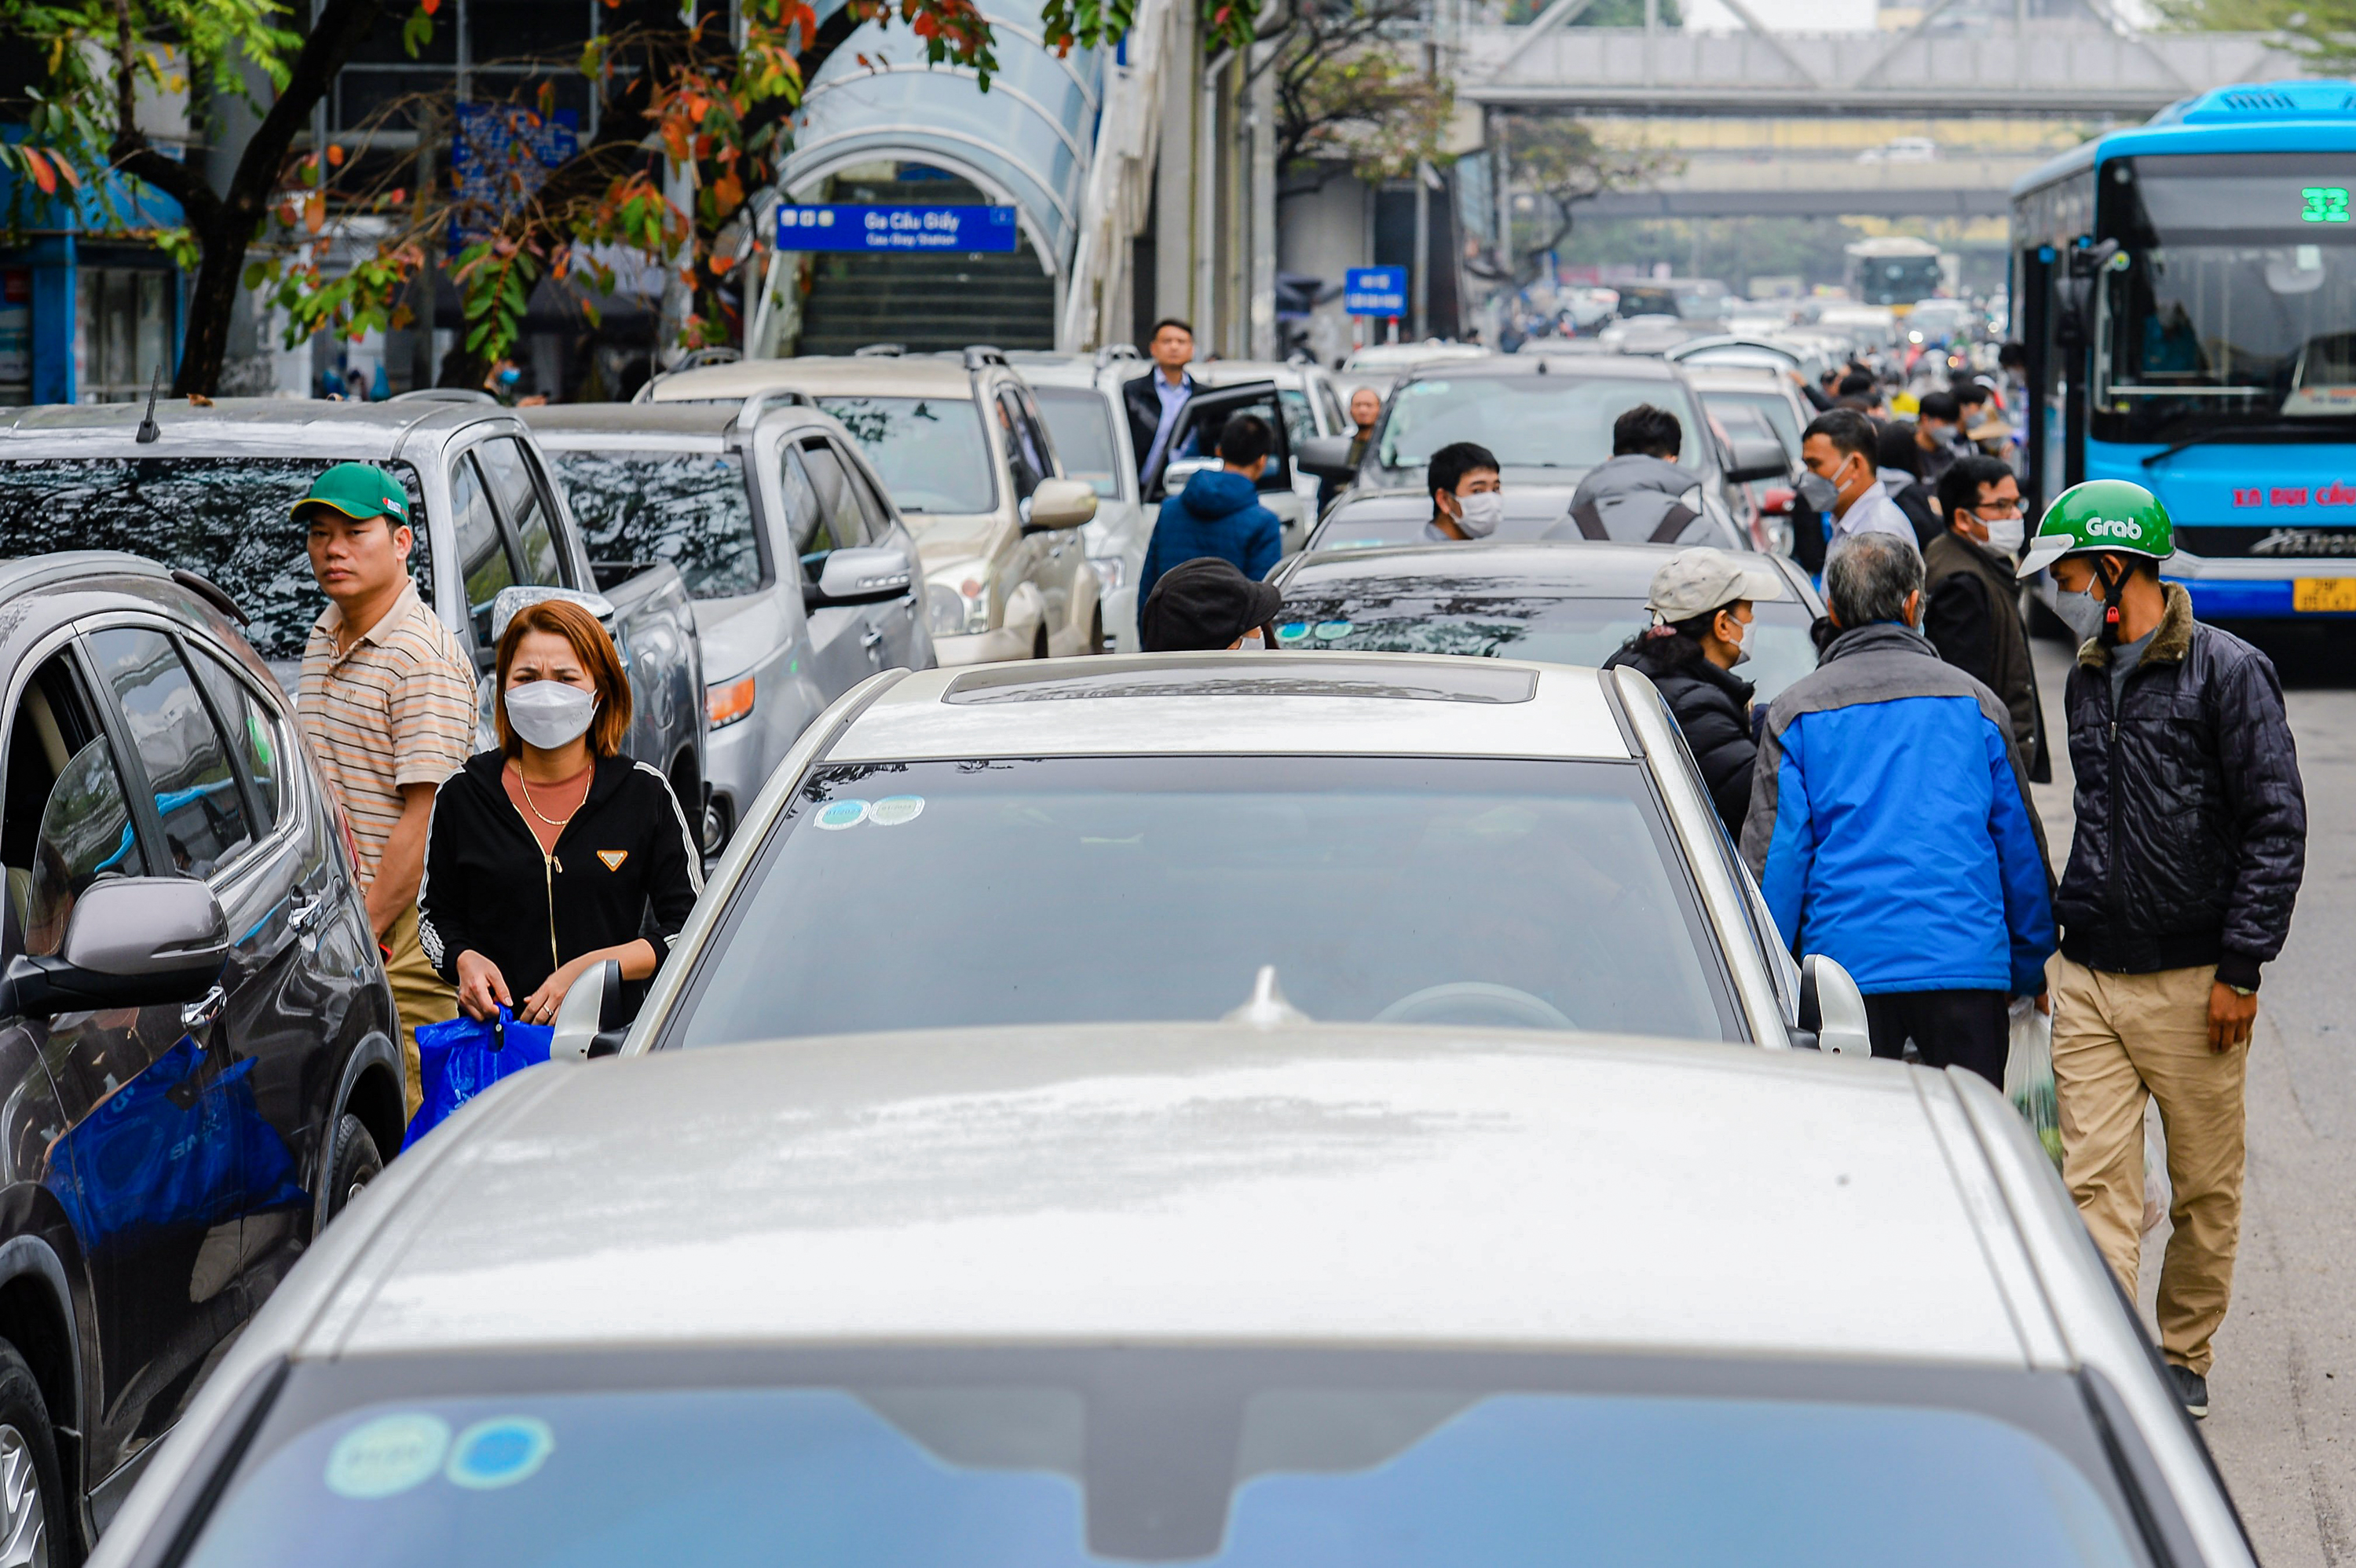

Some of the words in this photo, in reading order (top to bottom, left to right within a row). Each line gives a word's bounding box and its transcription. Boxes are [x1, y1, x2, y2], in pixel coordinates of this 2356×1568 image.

[2301, 187, 2350, 222] 32
[865, 211, 888, 230] Ga
[2086, 517, 2142, 539] Grab
